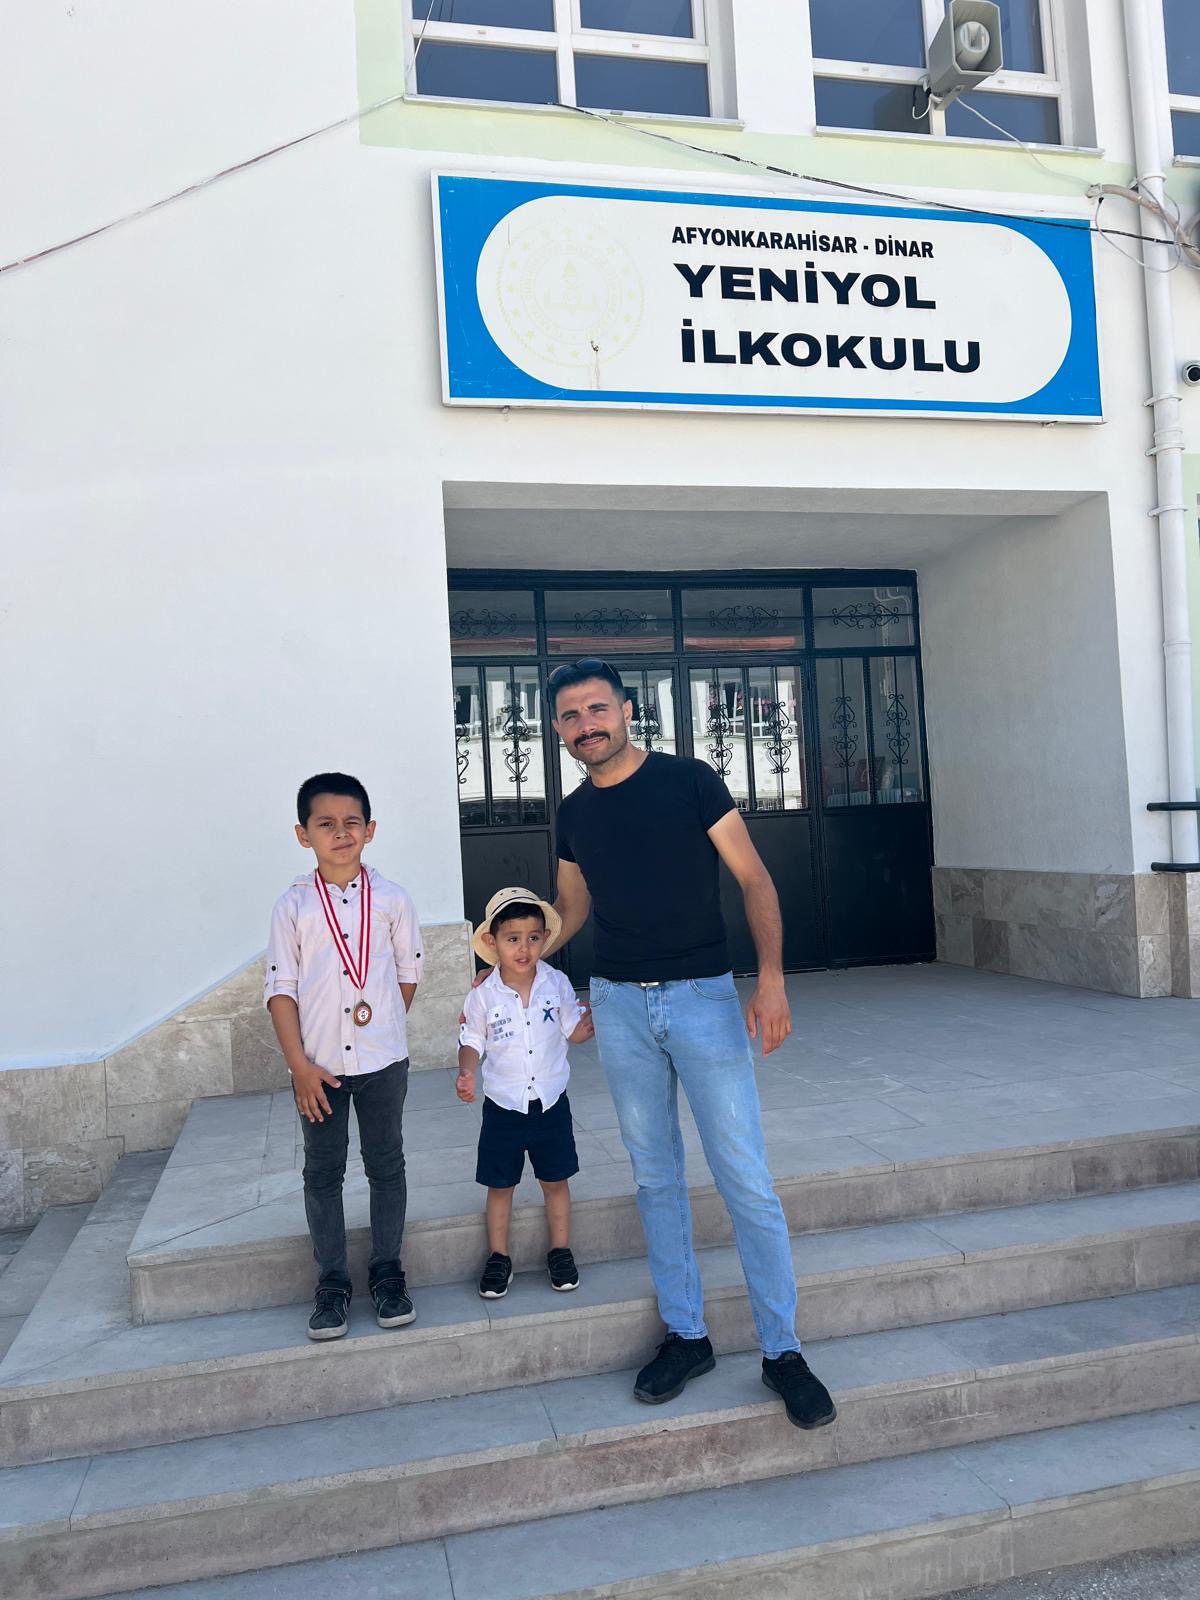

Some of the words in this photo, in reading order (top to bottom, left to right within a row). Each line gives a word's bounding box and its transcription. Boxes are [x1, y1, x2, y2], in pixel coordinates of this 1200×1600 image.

[671, 226, 858, 254] AFYONKARAHİSAR
[874, 234, 934, 259] DİNAR
[673, 260, 937, 310] YENİYOL
[680, 318, 981, 374] İLKOKULU
